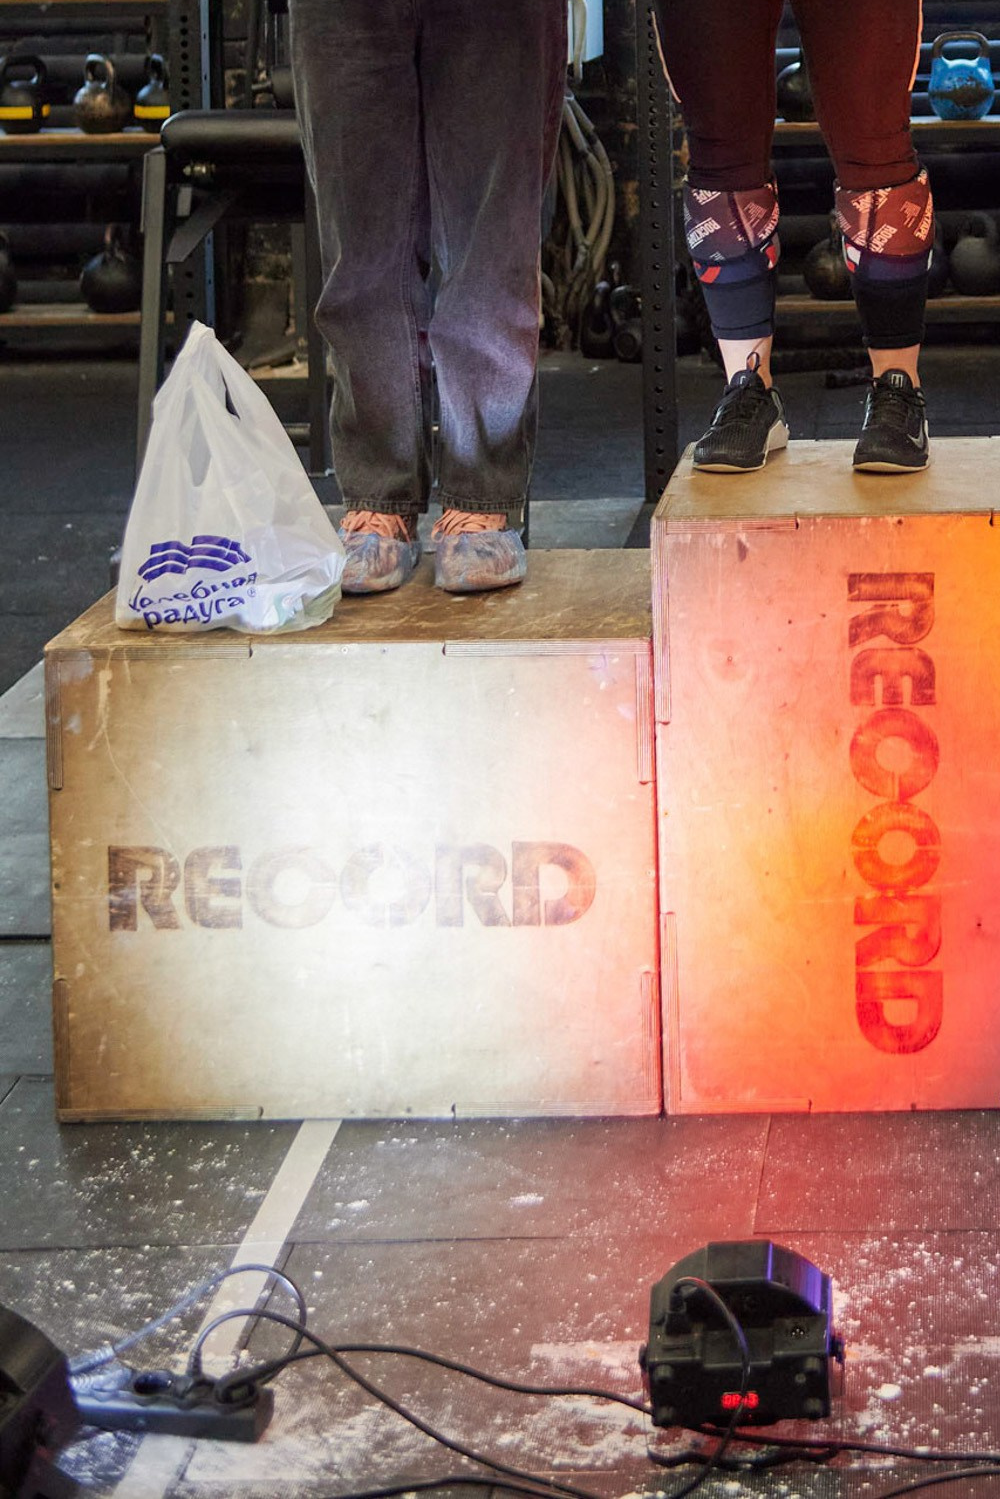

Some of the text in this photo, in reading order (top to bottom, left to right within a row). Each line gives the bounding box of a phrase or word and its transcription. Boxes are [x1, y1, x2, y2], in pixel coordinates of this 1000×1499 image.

[143, 596, 246, 630] радуга
[847, 572, 943, 1055] RECORD
[107, 840, 597, 932] RECORD
